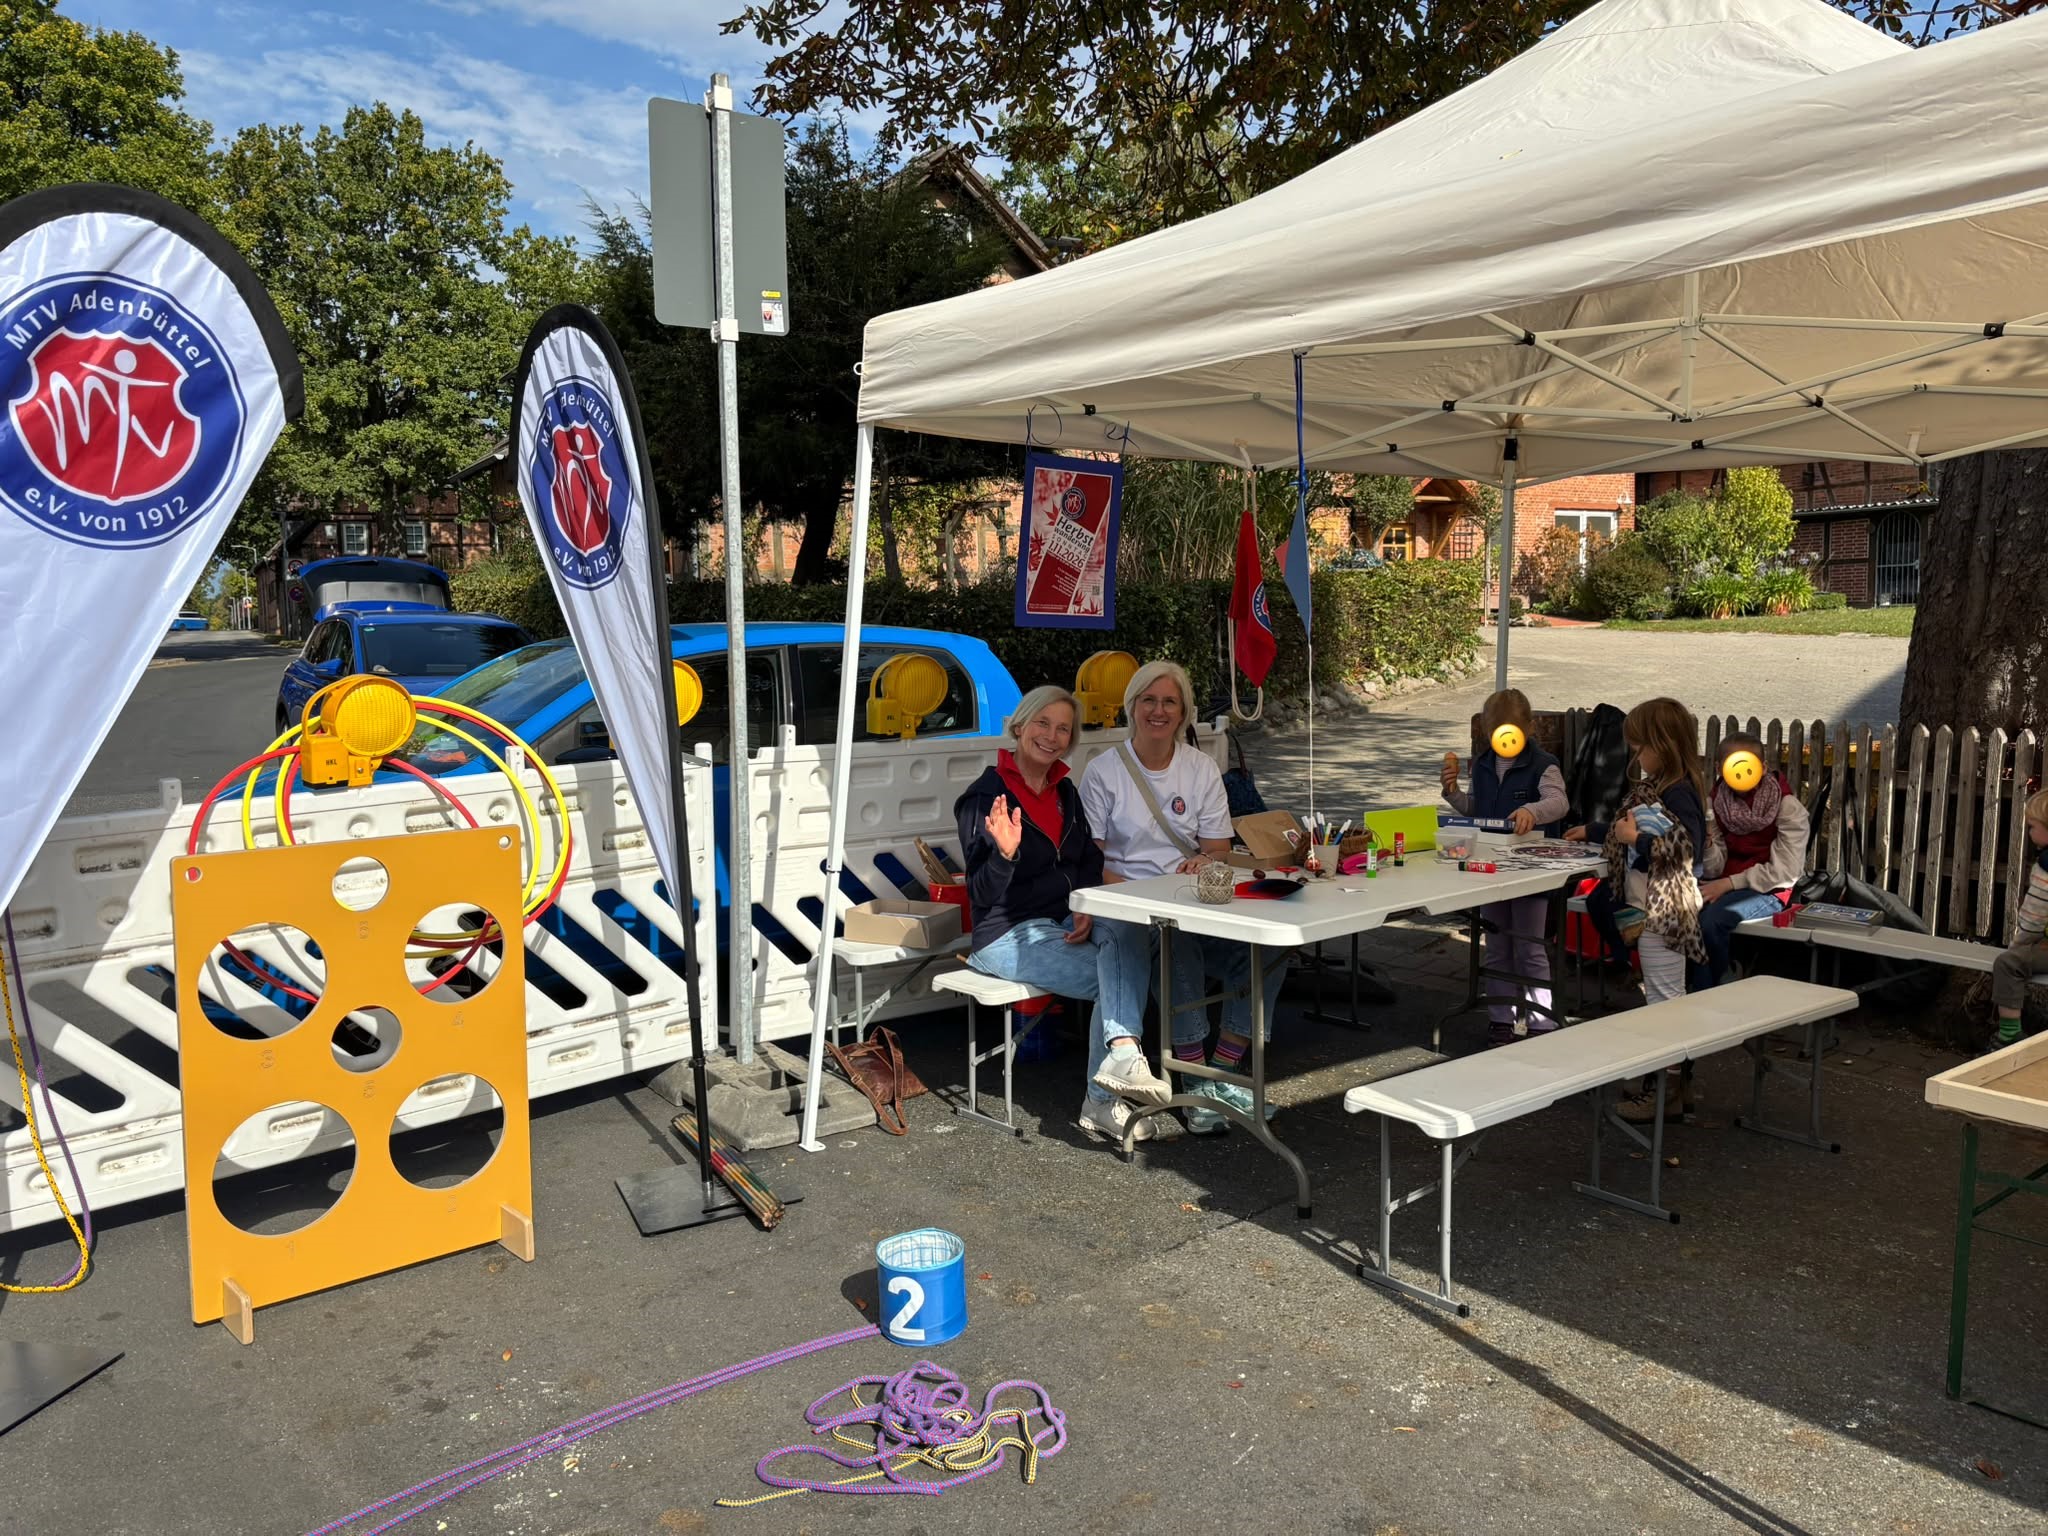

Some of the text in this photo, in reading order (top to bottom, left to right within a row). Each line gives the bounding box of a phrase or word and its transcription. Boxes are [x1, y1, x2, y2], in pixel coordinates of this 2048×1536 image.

[5, 289, 212, 369] MTV Adenbüttel
[24, 486, 189, 532] e.V. von 1912
[1054, 527, 1091, 553] wanderung
[1056, 516, 1094, 547] Herbst
[594, 544, 616, 574] 1912
[1048, 540, 1086, 569] 1.11.2026
[888, 1276, 925, 1341] 2
